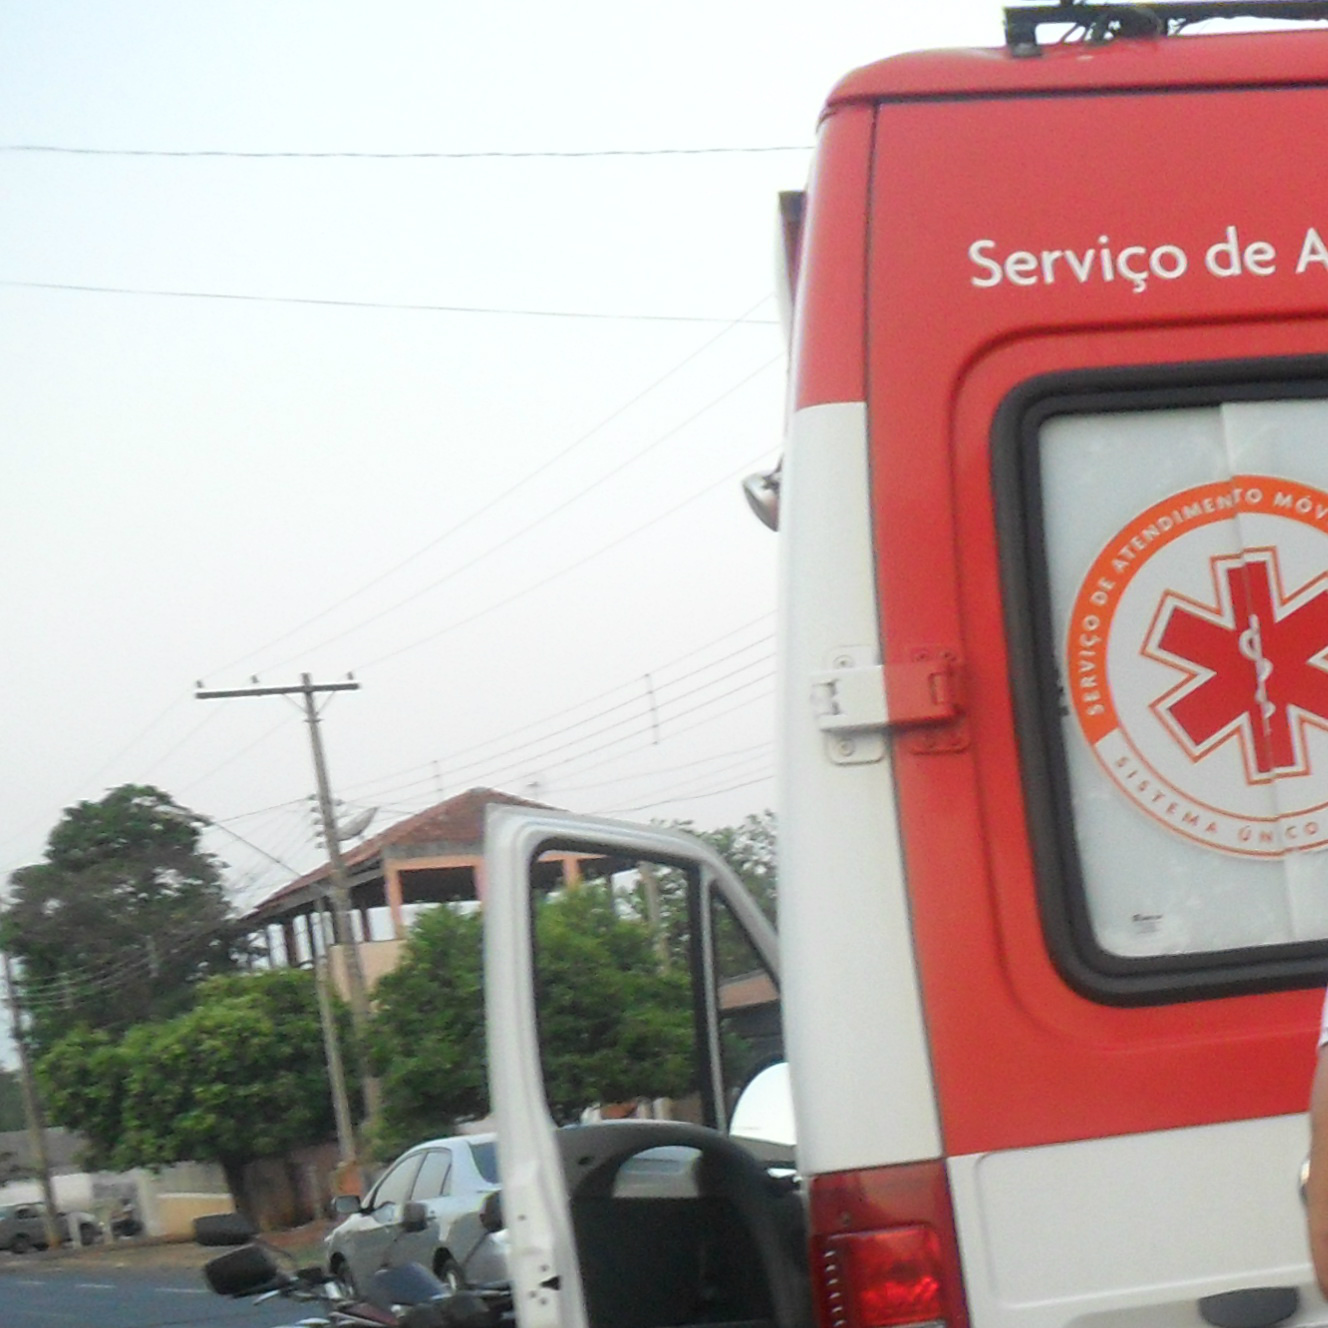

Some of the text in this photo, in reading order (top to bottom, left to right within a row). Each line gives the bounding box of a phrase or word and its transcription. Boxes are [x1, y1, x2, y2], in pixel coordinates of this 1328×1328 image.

[967, 235, 1188, 293] Serviço
[1204, 225, 1278, 278] de
[1111, 487, 1263, 573] ATENDIMENTO
[1090, 577, 1116, 606] DE
[1078, 614, 1105, 717] SERVIÇO
[1113, 754, 1217, 834] SISTEMA
